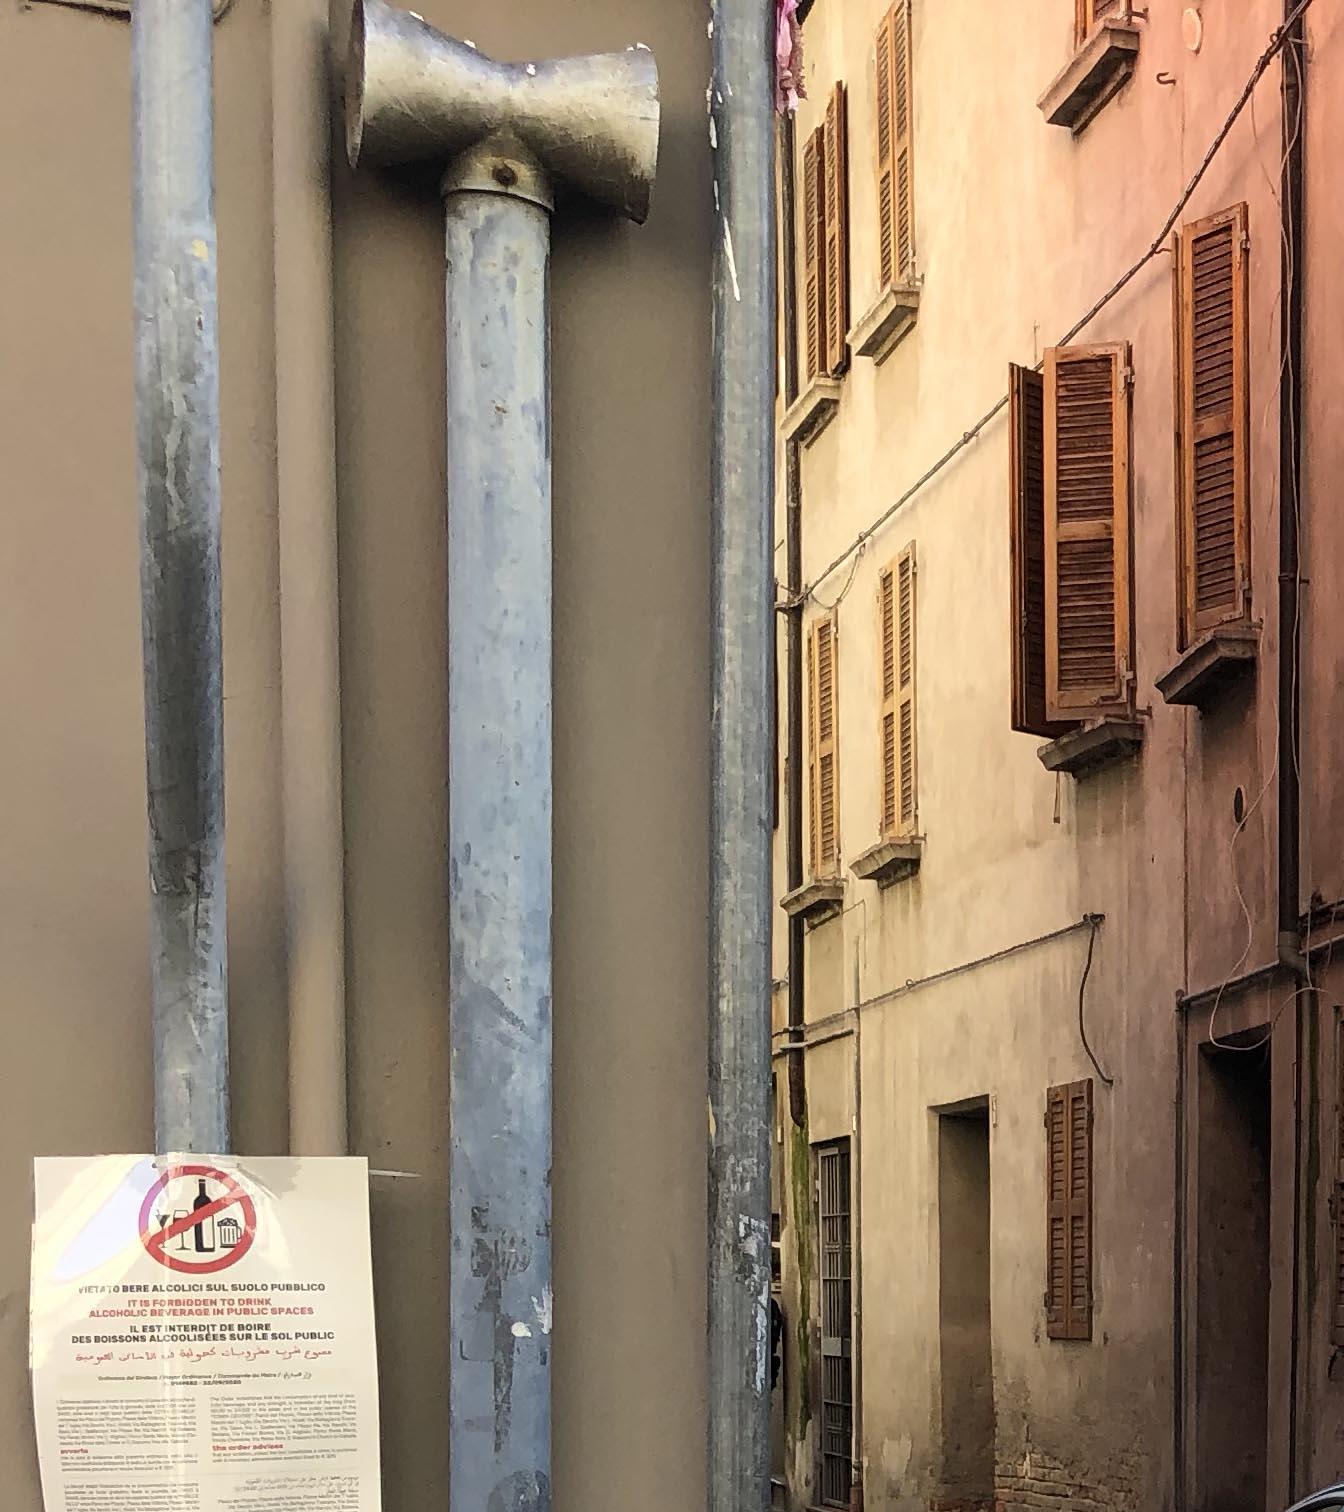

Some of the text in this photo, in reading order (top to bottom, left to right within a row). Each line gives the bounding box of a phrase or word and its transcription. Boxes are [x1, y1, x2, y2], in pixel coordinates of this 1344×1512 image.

[78, 1283, 326, 1294] VIETATO BERE ALCOLICI SUL SUOLO PUBBLICO
[128, 1298, 272, 1307] IT IS FORBIDDEN TO DRINK
[88, 1307, 314, 1318] ALCOHOLIC BEVERAGE IN PUBLIC SPACES
[129, 1323, 271, 1333] IL EST INTERDIT DE BOIRE
[71, 1331, 335, 1344] DES BOISSONS ALCOOLISÉES SUR LE SOL PUBLIC
